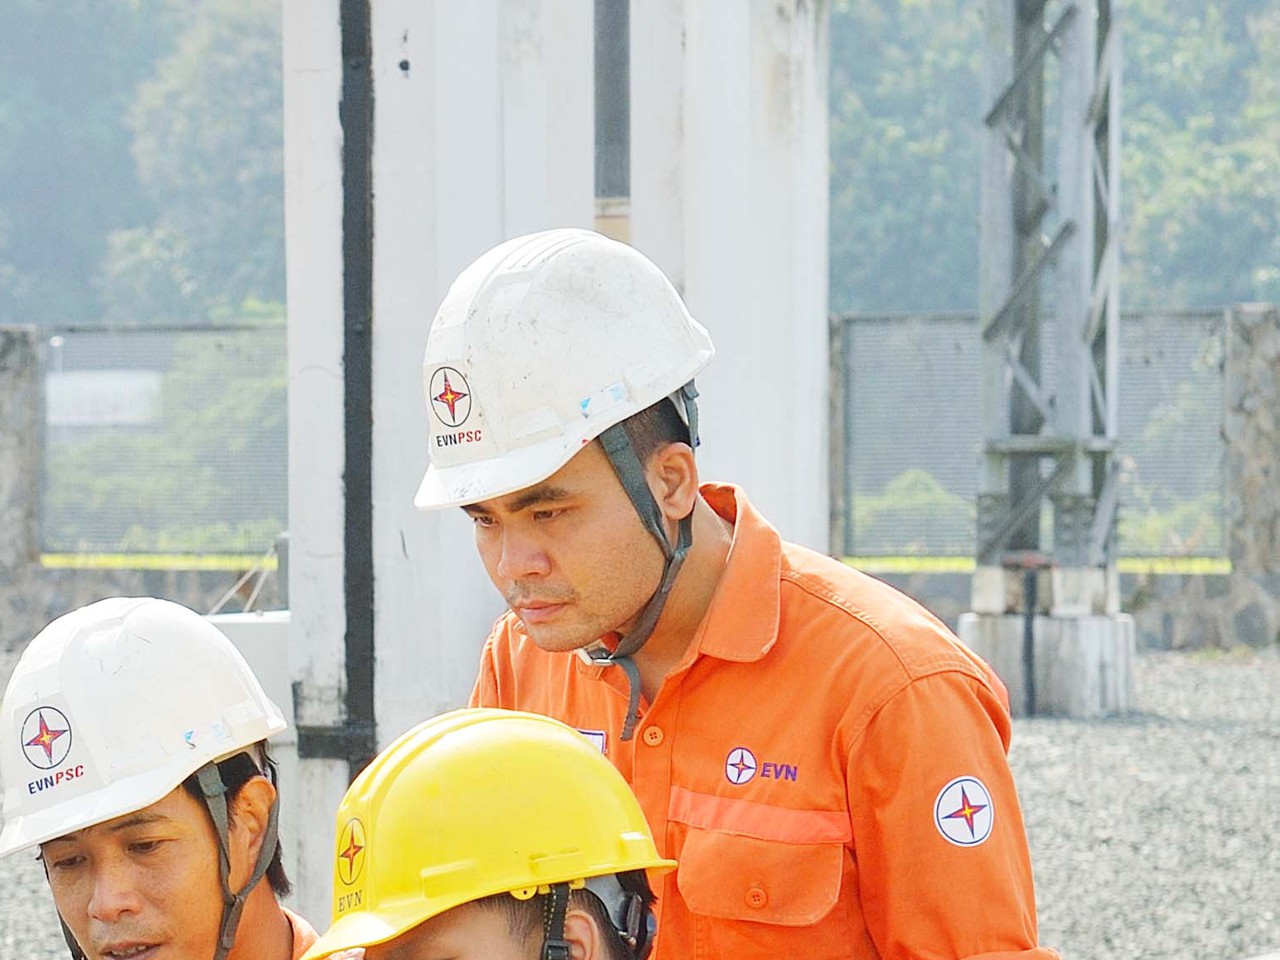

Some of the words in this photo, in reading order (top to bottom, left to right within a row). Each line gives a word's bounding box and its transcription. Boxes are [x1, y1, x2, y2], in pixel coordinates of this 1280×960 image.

[436, 430, 482, 447] EVNPSC
[28, 765, 84, 795] EVNPSC
[761, 762, 798, 782] EVN
[338, 889, 363, 912] EVN
